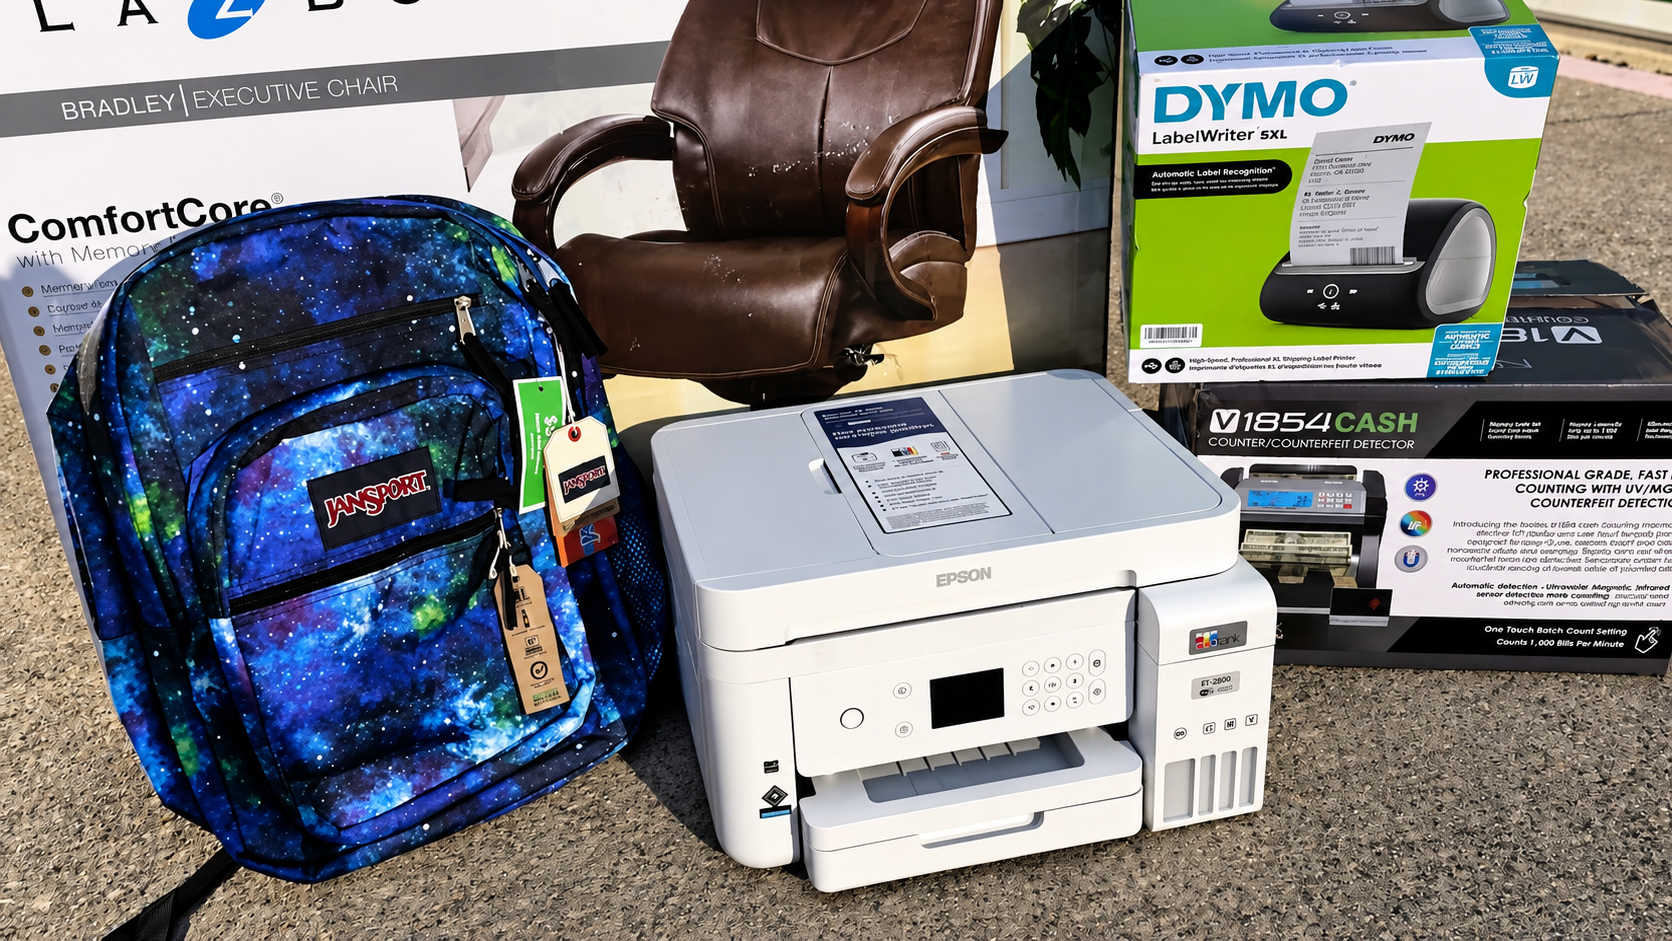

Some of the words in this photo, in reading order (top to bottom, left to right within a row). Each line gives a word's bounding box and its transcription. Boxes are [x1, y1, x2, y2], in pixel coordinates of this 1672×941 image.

[1511, 73, 1534, 84] LW
[61, 93, 175, 120] BRADLEY
[192, 81, 320, 109] EXECUTIVE
[327, 75, 398, 98] CHAIR
[1152, 129, 1254, 145] LabelWriter
[1373, 133, 1415, 143] DYMO
[1152, 170, 1194, 179] Automatic
[1197, 169, 1220, 177] Label
[17, 250, 63, 268] with
[1208, 437, 1350, 448] COUNTER/COUNTERFEIT
[1353, 439, 1415, 450] DETECTOR
[1484, 469, 1580, 480] PROFESSIONAL
[1584, 469, 1633, 480] GRADE,
[1638, 469, 1668, 480] FAST
[1515, 483, 1587, 494] COUNTING
[1591, 484, 1621, 494] WITH
[324, 470, 427, 528] JANSPORT
[1530, 498, 1615, 508] COUNTERFEIT
[1453, 521, 1500, 529] Introducing
[936, 566, 992, 588] EPSON
[1484, 625, 1503, 633] One
[1506, 626, 1534, 634] Touch
[1566, 627, 1594, 635] Count
[1596, 628, 1627, 637] Setting
[1496, 638, 1527, 646] Counts
[1530, 639, 1554, 647] 1,000
[1593, 640, 1624, 648] Minute
